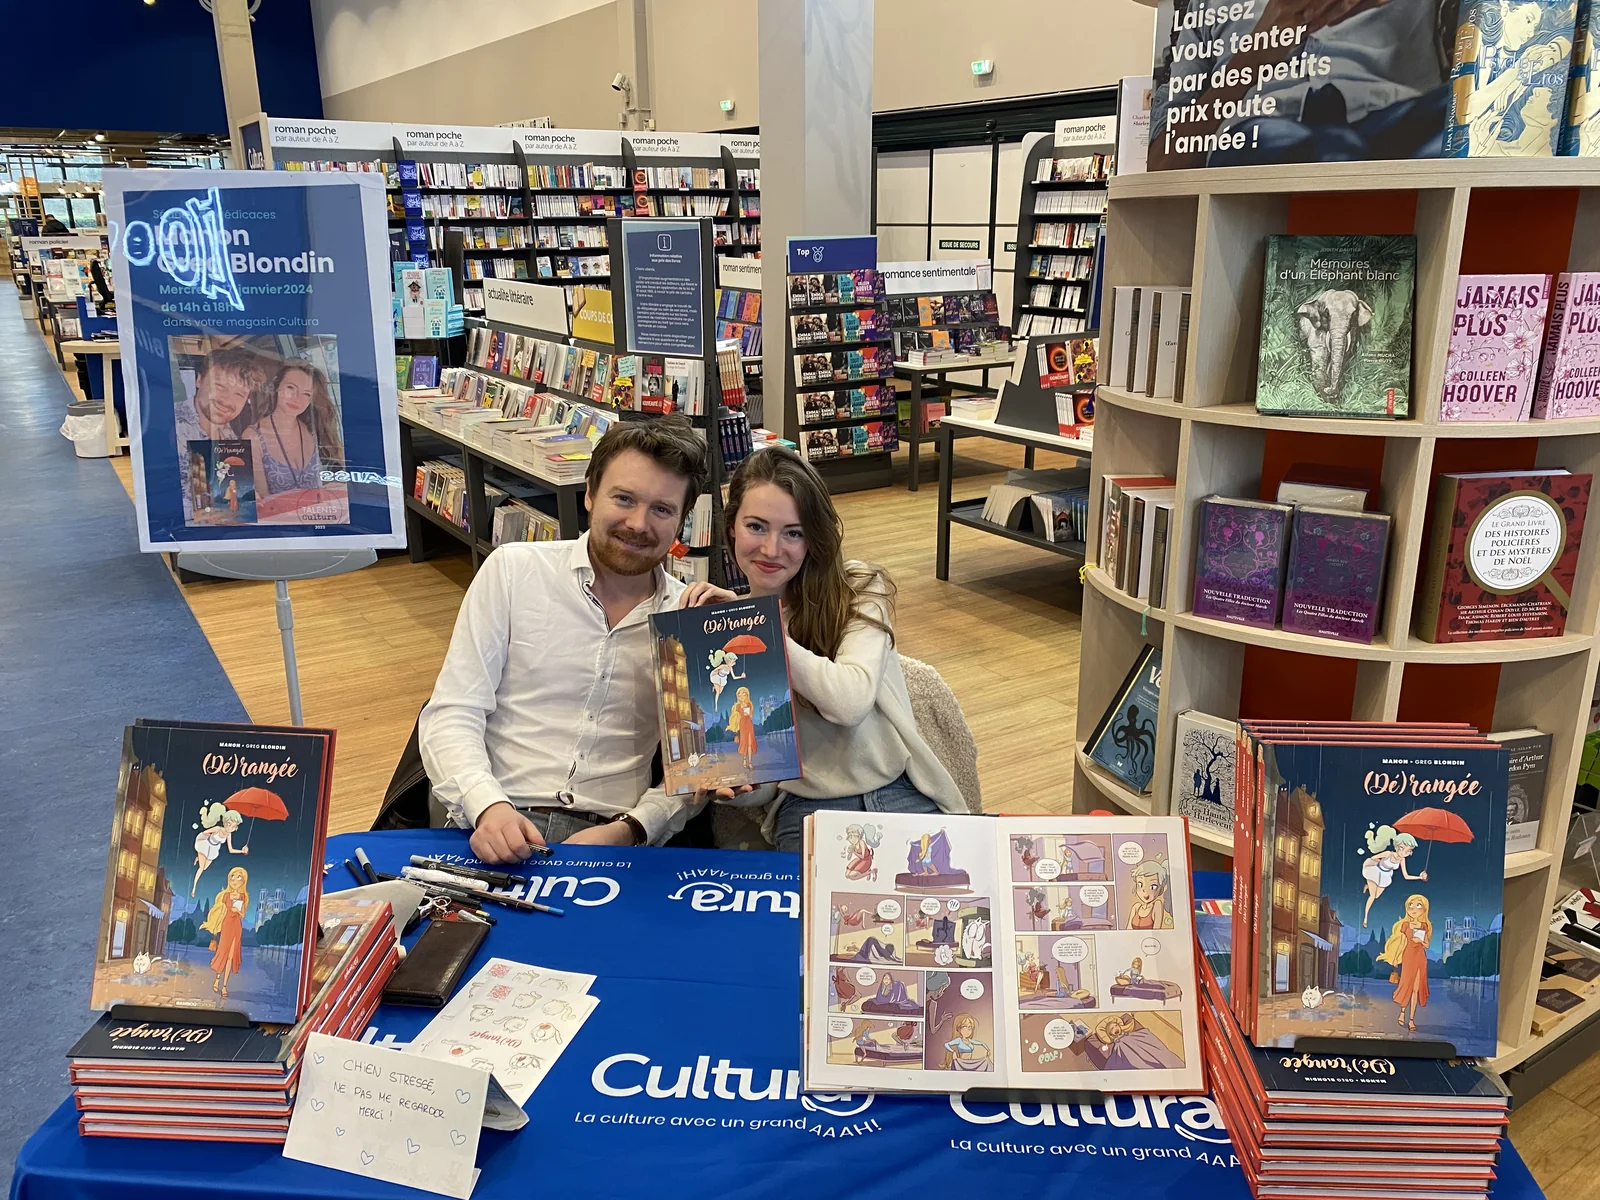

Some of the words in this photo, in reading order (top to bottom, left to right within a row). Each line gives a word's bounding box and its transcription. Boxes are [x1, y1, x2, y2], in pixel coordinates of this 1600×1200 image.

[1173, 1, 1255, 31] Laissez
[1172, 38, 1224, 63] vous
[1230, 23, 1307, 54] tenter
[1168, 71, 1207, 101] par
[1211, 64, 1252, 89] des
[1257, 52, 1331, 91] petits
[1166, 98, 1209, 131] prix
[1213, 93, 1276, 120] toute
[274, 125, 306, 134] roman
[307, 125, 337, 136] poche
[1063, 125, 1085, 134] roman
[1085, 123, 1106, 133] poche
[275, 135, 286, 143] par
[286, 134, 310, 143] auteur
[313, 135, 322, 143] de
[406, 130, 435, 139] roman
[435, 130, 462, 141] poche
[524, 134, 550, 143] roman
[551, 135, 576, 145] poche
[1164, 126, 1246, 155] l'année
[1252, 125, 1259, 149] !
[407, 140, 417, 148] par
[419, 139, 442, 147] auteur
[442, 139, 449, 147] de
[525, 143, 535, 151] par
[536, 142, 554, 150] auteur
[555, 142, 562, 150] de
[632, 138, 656, 146] roman
[656, 137, 679, 147] poche
[730, 139, 749, 148] roman
[222, 208, 276, 220] édicaces
[796, 248, 810, 257] Top
[231, 251, 335, 274] Blondin
[723, 264, 738, 272] roman
[1310, 258, 1370, 269] Mémoires
[882, 270, 921, 279] romance
[922, 267, 976, 278] sentimentale
[1279, 270, 1306, 281] d'un
[1309, 269, 1363, 283] Éléphant
[1366, 270, 1400, 281] blanc
[237, 284, 282, 297] janvier
[284, 284, 314, 295] 2024
[1457, 285, 1540, 309] JAMAIS
[161, 302, 179, 312] de
[179, 302, 200, 312] 14h
[203, 301, 211, 312] à
[212, 302, 234, 312] 18h
[580, 309, 598, 322] COUPS
[598, 311, 606, 323] DE
[1546, 312, 1564, 355] JAMAIS
[1555, 281, 1570, 311] PLUS
[163, 317, 192, 327] dans
[194, 318, 223, 327] votre
[226, 317, 276, 331] magasin
[278, 316, 319, 327] Cultura
[1452, 314, 1508, 337] PLUS
[1459, 370, 1507, 382] COLLEEN
[1442, 384, 1517, 403] HOOVER
[302, 506, 338, 515] TALENTS
[302, 514, 338, 522] Cultura
[1500, 520, 1526, 528] GRAND
[1527, 519, 1547, 527] LIVRE
[1484, 530, 1501, 538] DES
[1503, 528, 1551, 537] HISTOIRES
[1490, 536, 1541, 548] POLICIÈRES
[1476, 549, 1486, 557] ET
[1507, 545, 1552, 556] MYSTÈRES
[1493, 558, 1505, 566] DE
[1507, 555, 1532, 565] NOËL
[1203, 588, 1232, 599] NOUVELLE
[1232, 593, 1271, 605] TRADUCTION
[1293, 602, 1325, 612] NOUVELLE
[1326, 607, 1369, 619] TRADUCTION
[703, 611, 767, 635] (Dé)rangée
[1518, 754, 1544, 763] d'Arthur
[202, 752, 299, 784] (Dé)rangée
[1522, 763, 1536, 771] Pym
[1363, 770, 1483, 803] (Dé)rangée
[1193, 811, 1234, 830] Hurlevent
[1202, 807, 1227, 823] Hauts
[529, 859, 563, 868] avec
[566, 859, 613, 869] culture
[676, 868, 730, 881] AAAH!
[730, 872, 772, 881] grand
[108, 1023, 213, 1044] (Dé)rangée
[469, 1030, 523, 1049] (Dé)rangée
[1279, 1053, 1396, 1076] (Dé)rangée
[333, 1081, 346, 1094] NE
[354, 1086, 372, 1099] PAS
[378, 1091, 392, 1104] ME
[574, 1111, 596, 1124] La
[599, 1111, 665, 1126] culture
[670, 1116, 716, 1128] avec
[721, 1117, 744, 1128] un
[749, 1117, 807, 1131] grand
[808, 1118, 882, 1138] AAAH!
[950, 1139, 972, 1150] La
[976, 1141, 1045, 1155] culture
[1050, 1144, 1097, 1155] avec
[1101, 1145, 1127, 1157] un
[1132, 1146, 1192, 1161] grand
